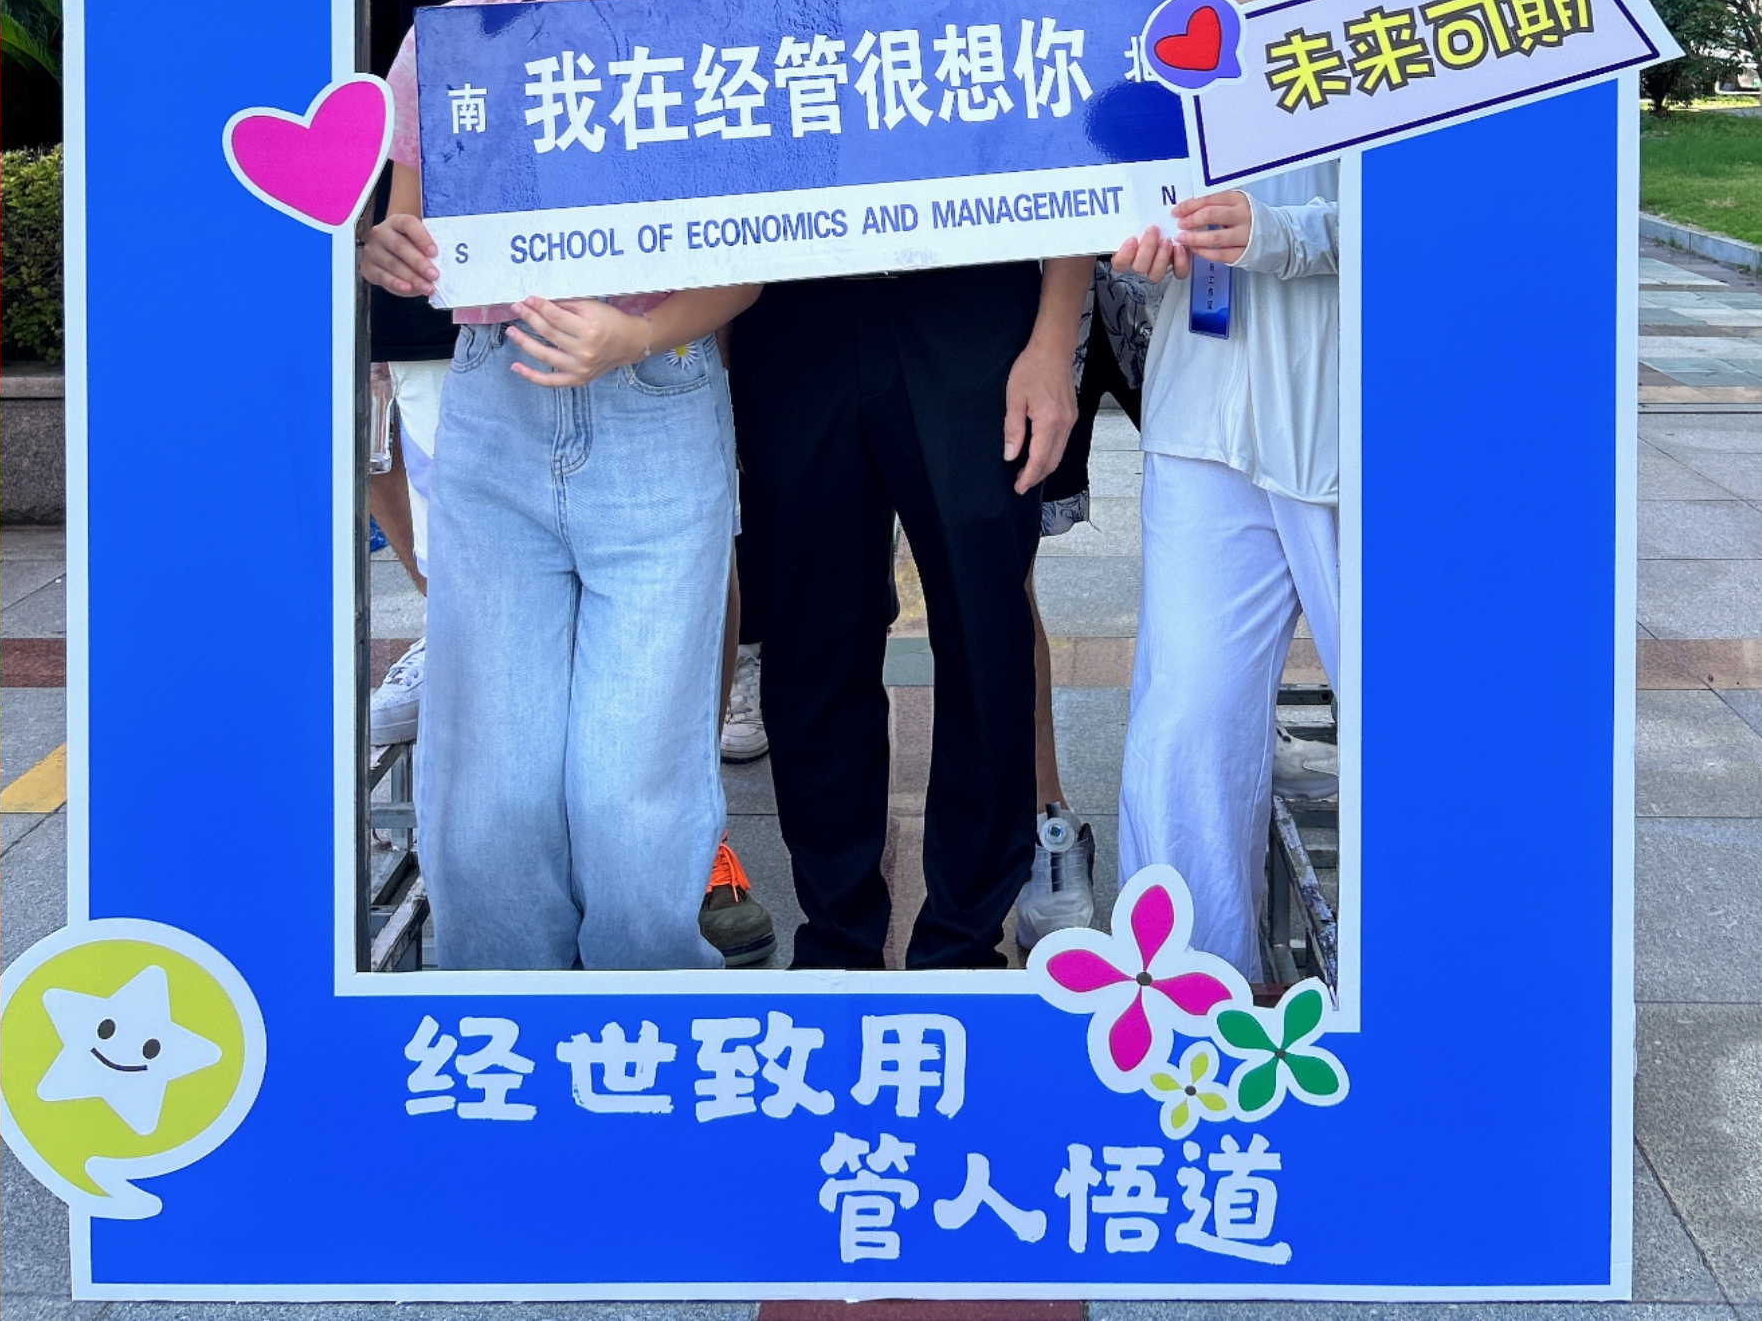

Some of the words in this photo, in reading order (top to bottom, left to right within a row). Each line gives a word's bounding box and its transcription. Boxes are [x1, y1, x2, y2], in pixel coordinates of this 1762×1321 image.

[449, 82, 488, 135] 南
[524, 16, 1094, 155] 我在经管很想你
[455, 243, 469, 264] S
[510, 227, 625, 264] SCHOOL
[637, 224, 674, 255] OF
[687, 208, 849, 251] ECONOMICS
[861, 202, 919, 236] AND
[932, 186, 1125, 230] MANAGEMENT
[1162, 186, 1177, 207] N
[404, 1011, 966, 1122] 经世致用
[819, 1133, 1293, 1265] 管人悟道
